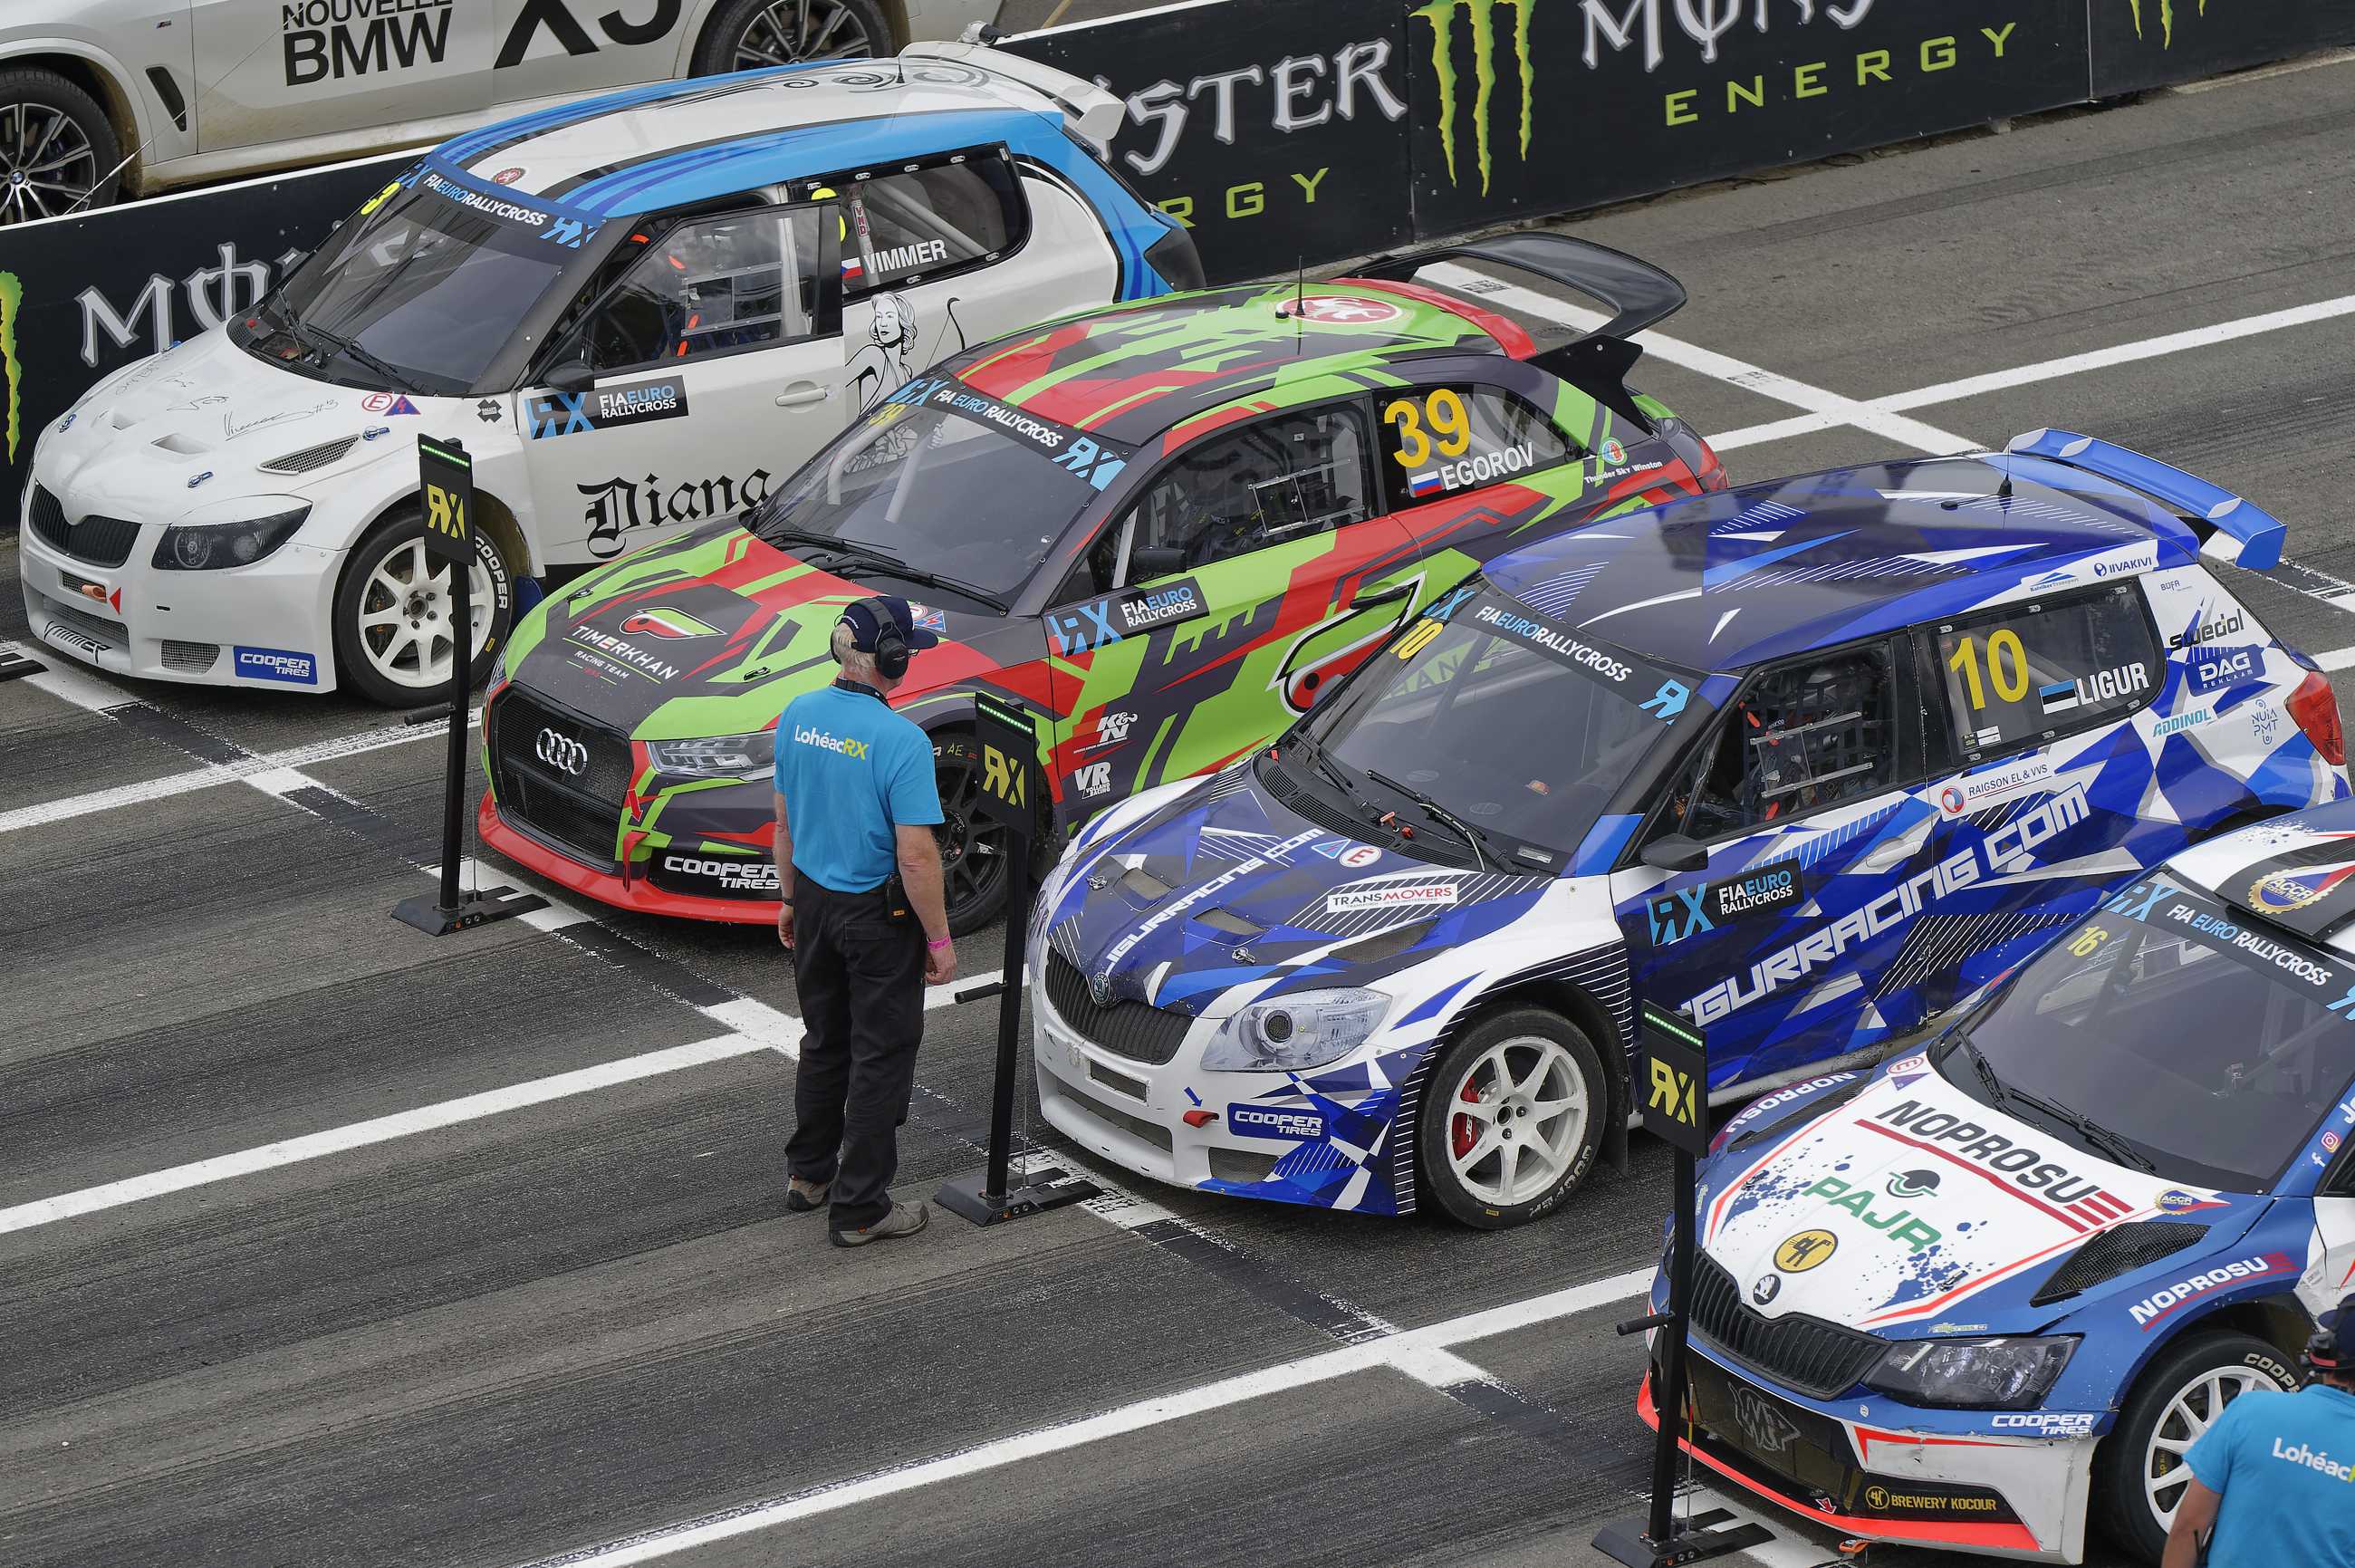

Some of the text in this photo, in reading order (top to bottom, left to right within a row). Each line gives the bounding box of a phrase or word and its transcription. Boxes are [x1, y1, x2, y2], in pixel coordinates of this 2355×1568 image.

[284, 7, 453, 86] BMW
[1665, 23, 2016, 127] ENERGY
[864, 239, 947, 274] VIMMER
[601, 398, 678, 419] RALLYCROSS
[984, 404, 1064, 448] RALLYCROSS
[1384, 389, 1471, 468] 39
[1440, 441, 1534, 491] EGOROV
[576, 467, 772, 558] Diana
[476, 535, 508, 610] COOPER
[1125, 599, 1197, 628] RALLYCROSS
[1389, 618, 1444, 660] 10
[2169, 608, 2244, 651] swedol
[240, 653, 311, 669] COOPER
[572, 626, 679, 680] TIMERKHAN
[574, 649, 603, 669] RACING
[604, 664, 630, 679] TEAM
[2198, 651, 2252, 682] DAG
[274, 665, 311, 678] TIRES
[1949, 629, 2029, 710] 10
[2077, 662, 2150, 705] LIGUR
[2152, 707, 2212, 737] ADDINOL
[1074, 761, 1111, 792] VR
[1968, 776, 2009, 796] RAIGSON
[2011, 772, 2022, 784] EL
[2030, 765, 2048, 776] VVS
[719, 877, 781, 890] TIRES
[1720, 885, 1793, 915] RALLYCROSS
[2067, 926, 2108, 957] 16
[2167, 904, 2333, 987] FIA EURO RALLYCROSS
[1235, 1110, 1323, 1129] COOPER
[1276, 1125, 1322, 1137] TIRES
[2129, 1255, 2270, 1325] NOPROSU
[1991, 1413, 2094, 1429] COOPER
[2040, 1426, 2091, 1436] TIRES
[1891, 1494, 1997, 1511] BREWERY KOCOUR
